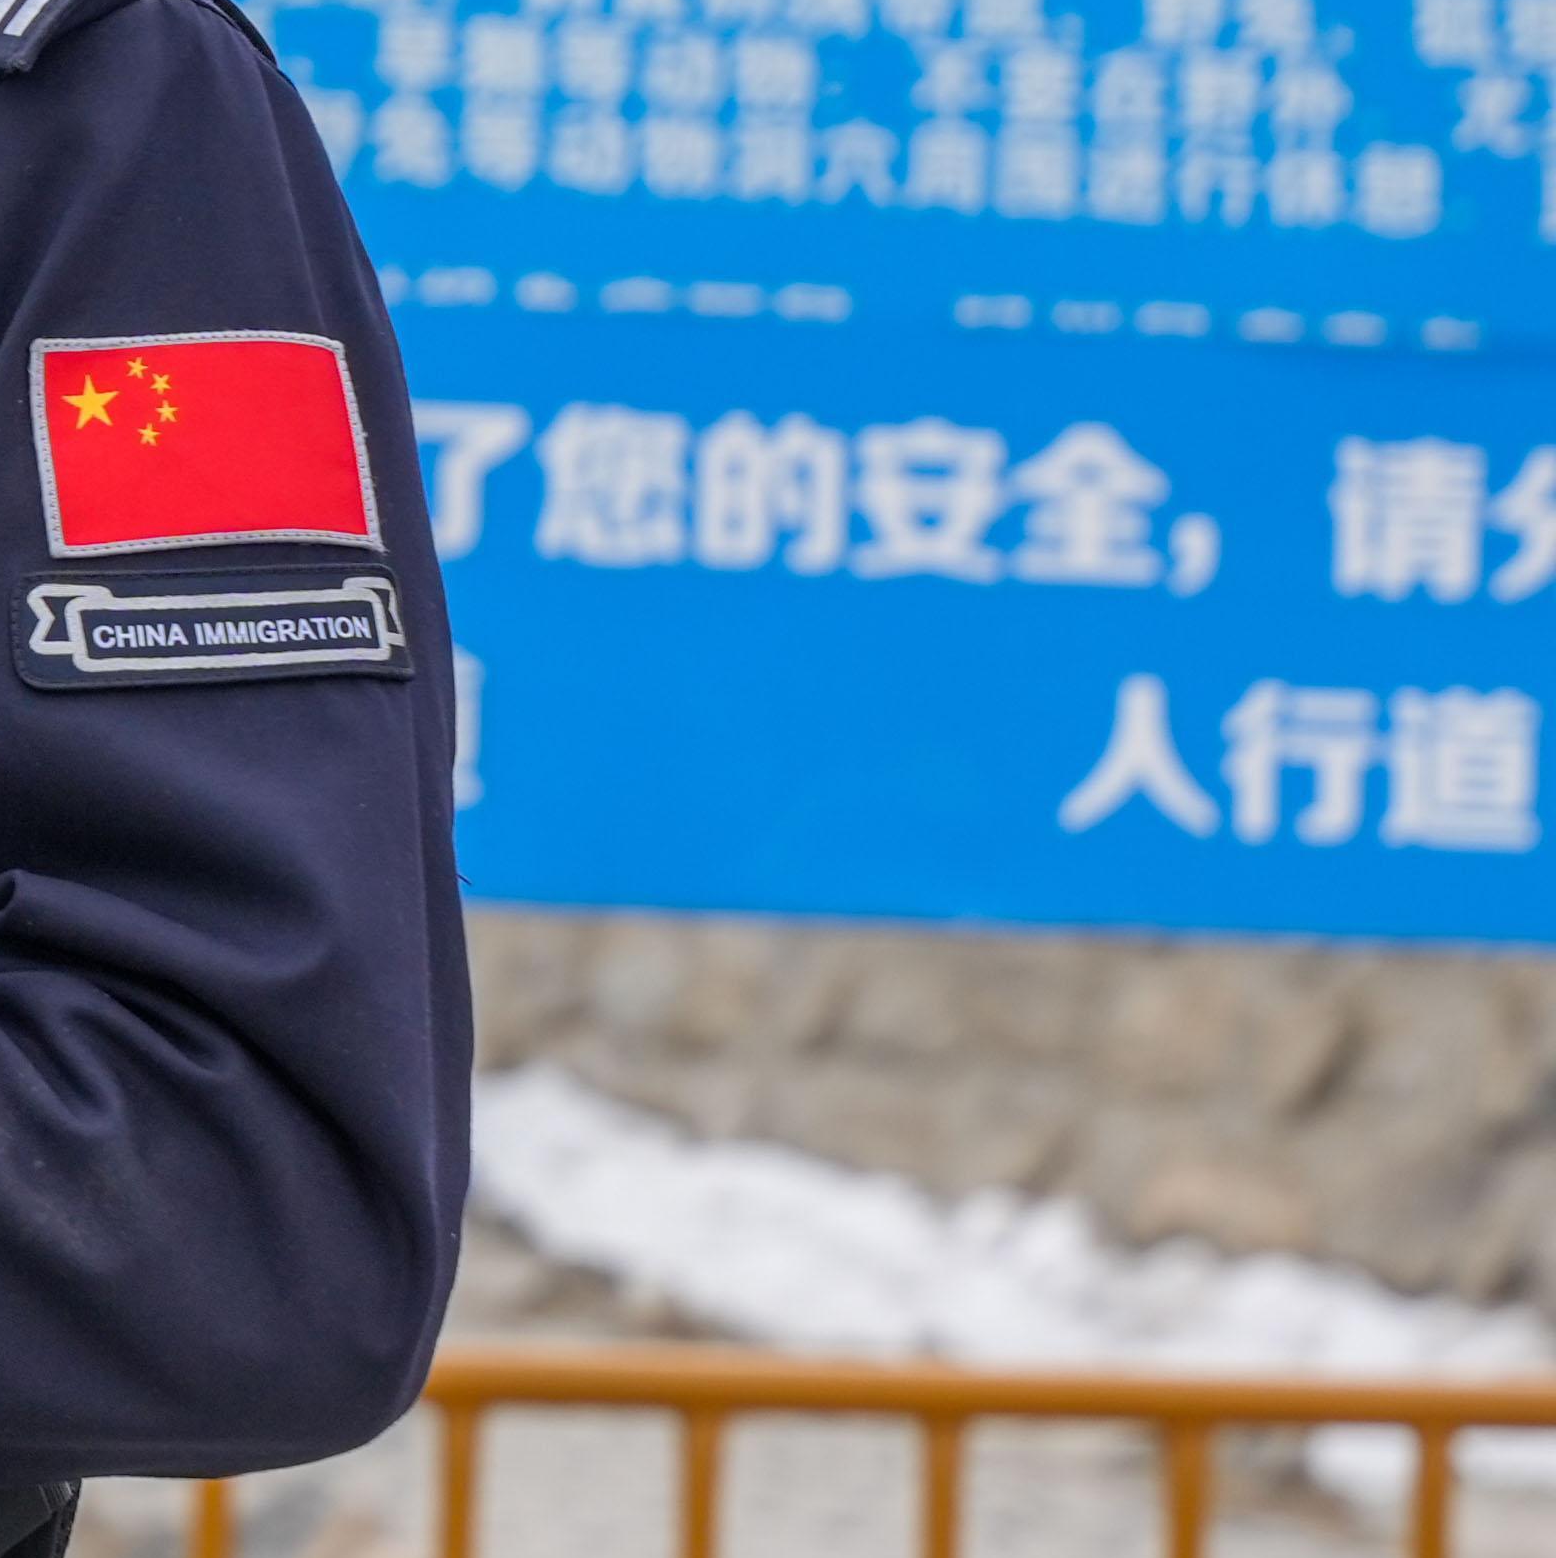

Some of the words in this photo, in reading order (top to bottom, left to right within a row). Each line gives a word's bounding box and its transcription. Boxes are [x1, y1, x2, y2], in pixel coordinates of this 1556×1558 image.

[91, 626, 183, 649] CHINA
[194, 614, 373, 645] IMMIGRATION
[1057, 671, 1542, 855] 人行道
